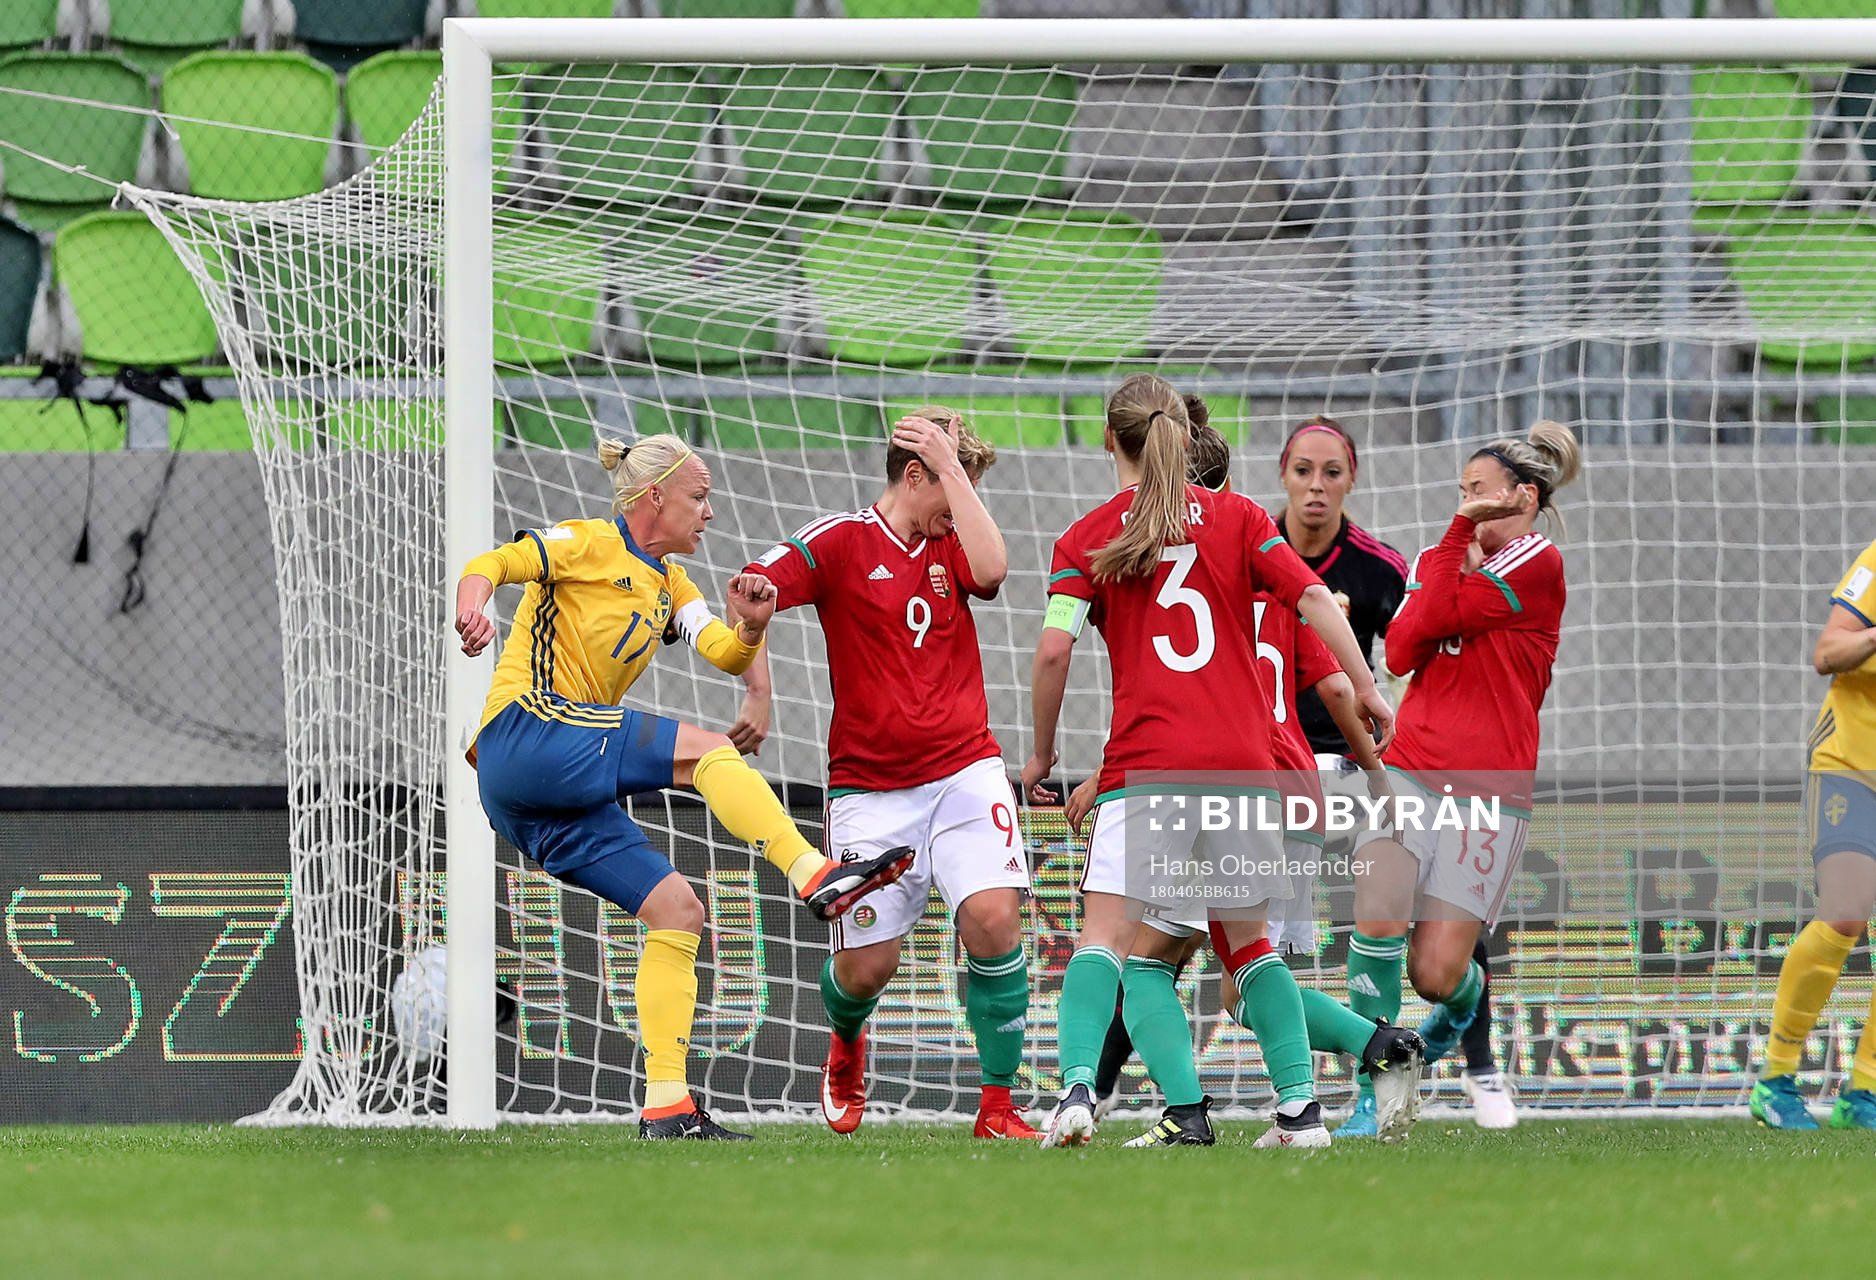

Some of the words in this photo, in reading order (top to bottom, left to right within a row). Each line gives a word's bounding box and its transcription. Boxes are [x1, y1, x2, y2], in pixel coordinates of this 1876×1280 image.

[906, 596, 932, 648] 9
[1151, 543, 1216, 673] 3
[610, 610, 653, 664] 17
[991, 802, 1013, 848] 9
[1457, 825, 1498, 875] 13
